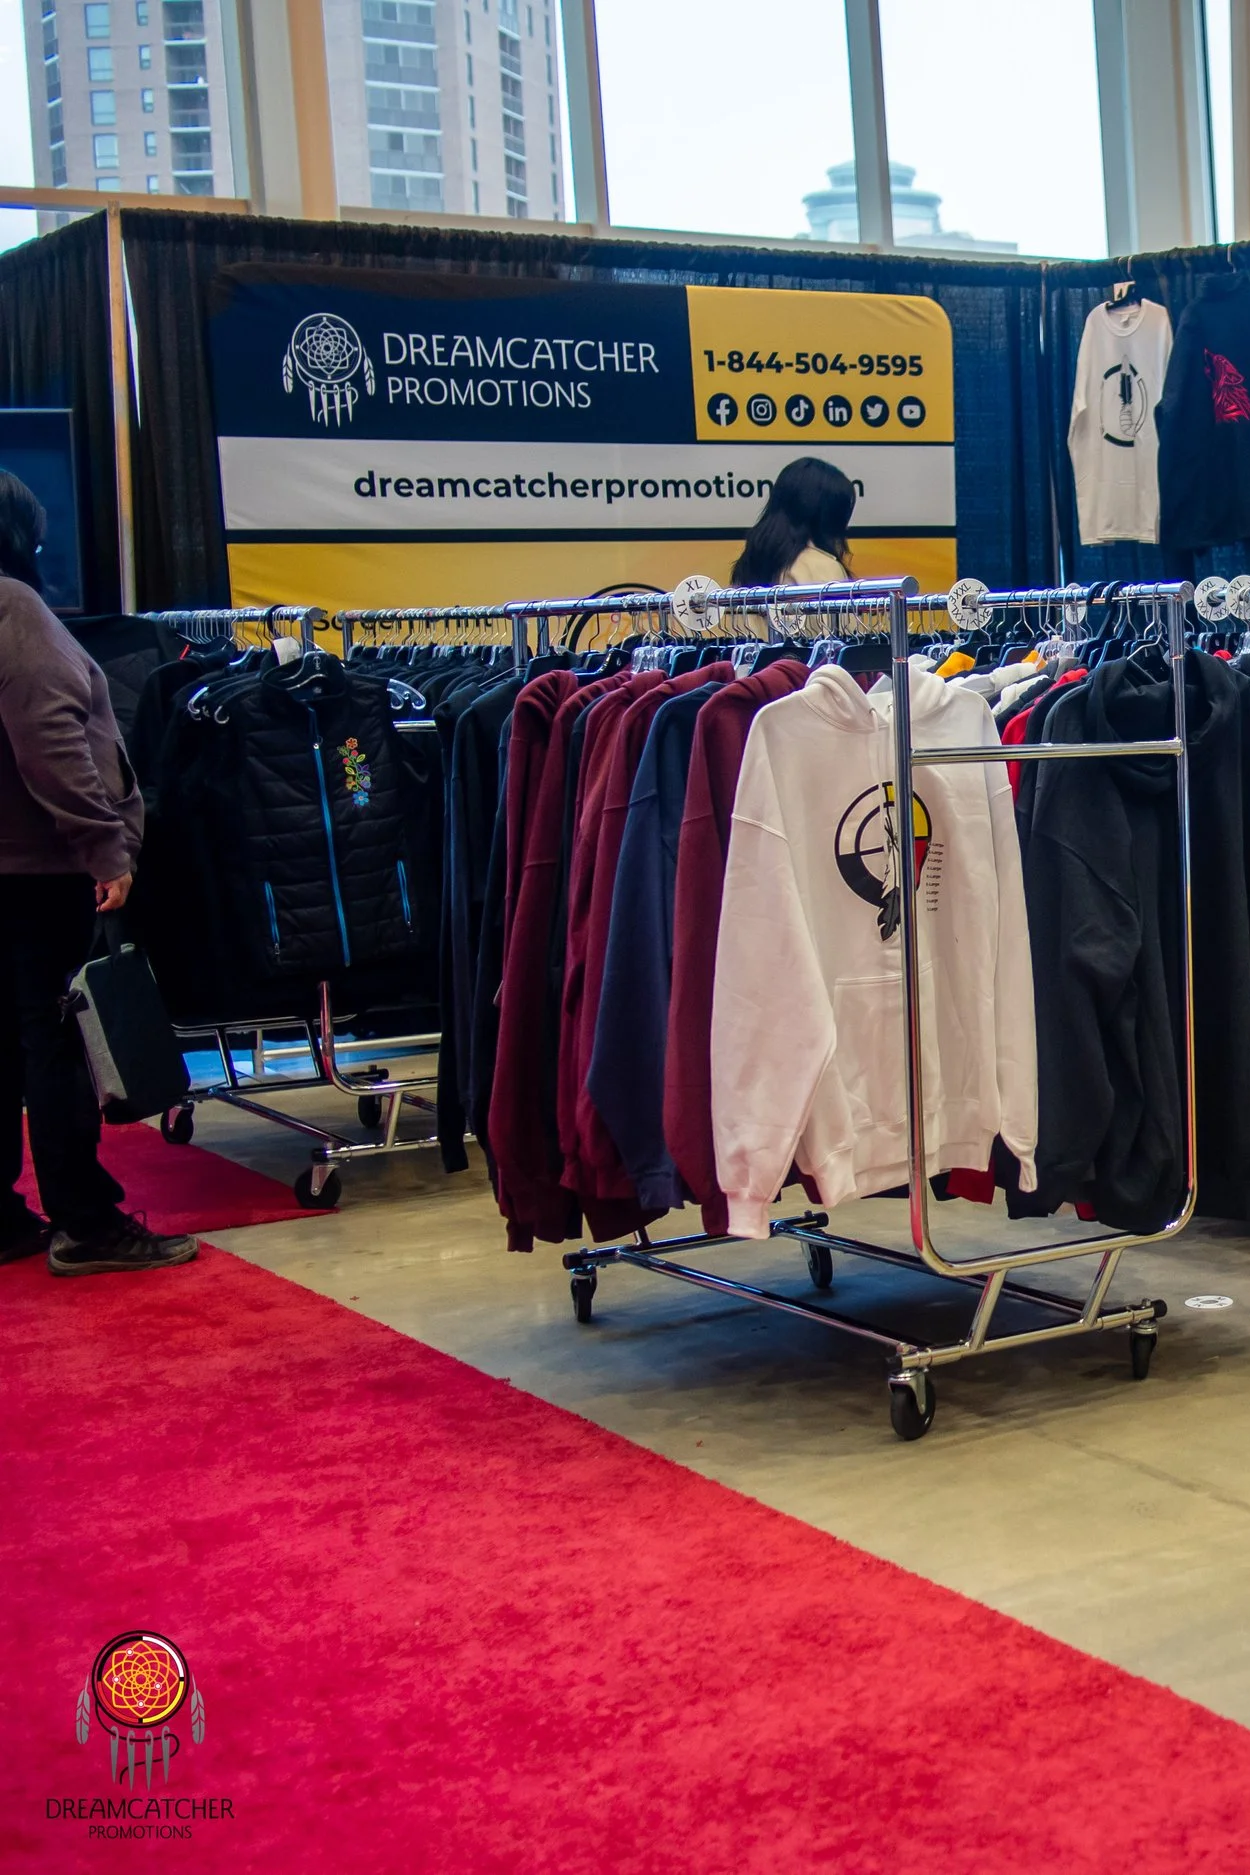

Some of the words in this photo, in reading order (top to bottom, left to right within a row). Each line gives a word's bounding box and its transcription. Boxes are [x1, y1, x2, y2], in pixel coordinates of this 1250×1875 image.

[383, 332, 660, 373] DREAMCATCHER
[703, 349, 924, 377] 1-844-504-9595
[387, 376, 592, 409] PROMOTIONS
[353, 469, 865, 505] dreamcatcherpromotion
[686, 578, 703, 593] XL
[1200, 580, 1216, 594] XXL
